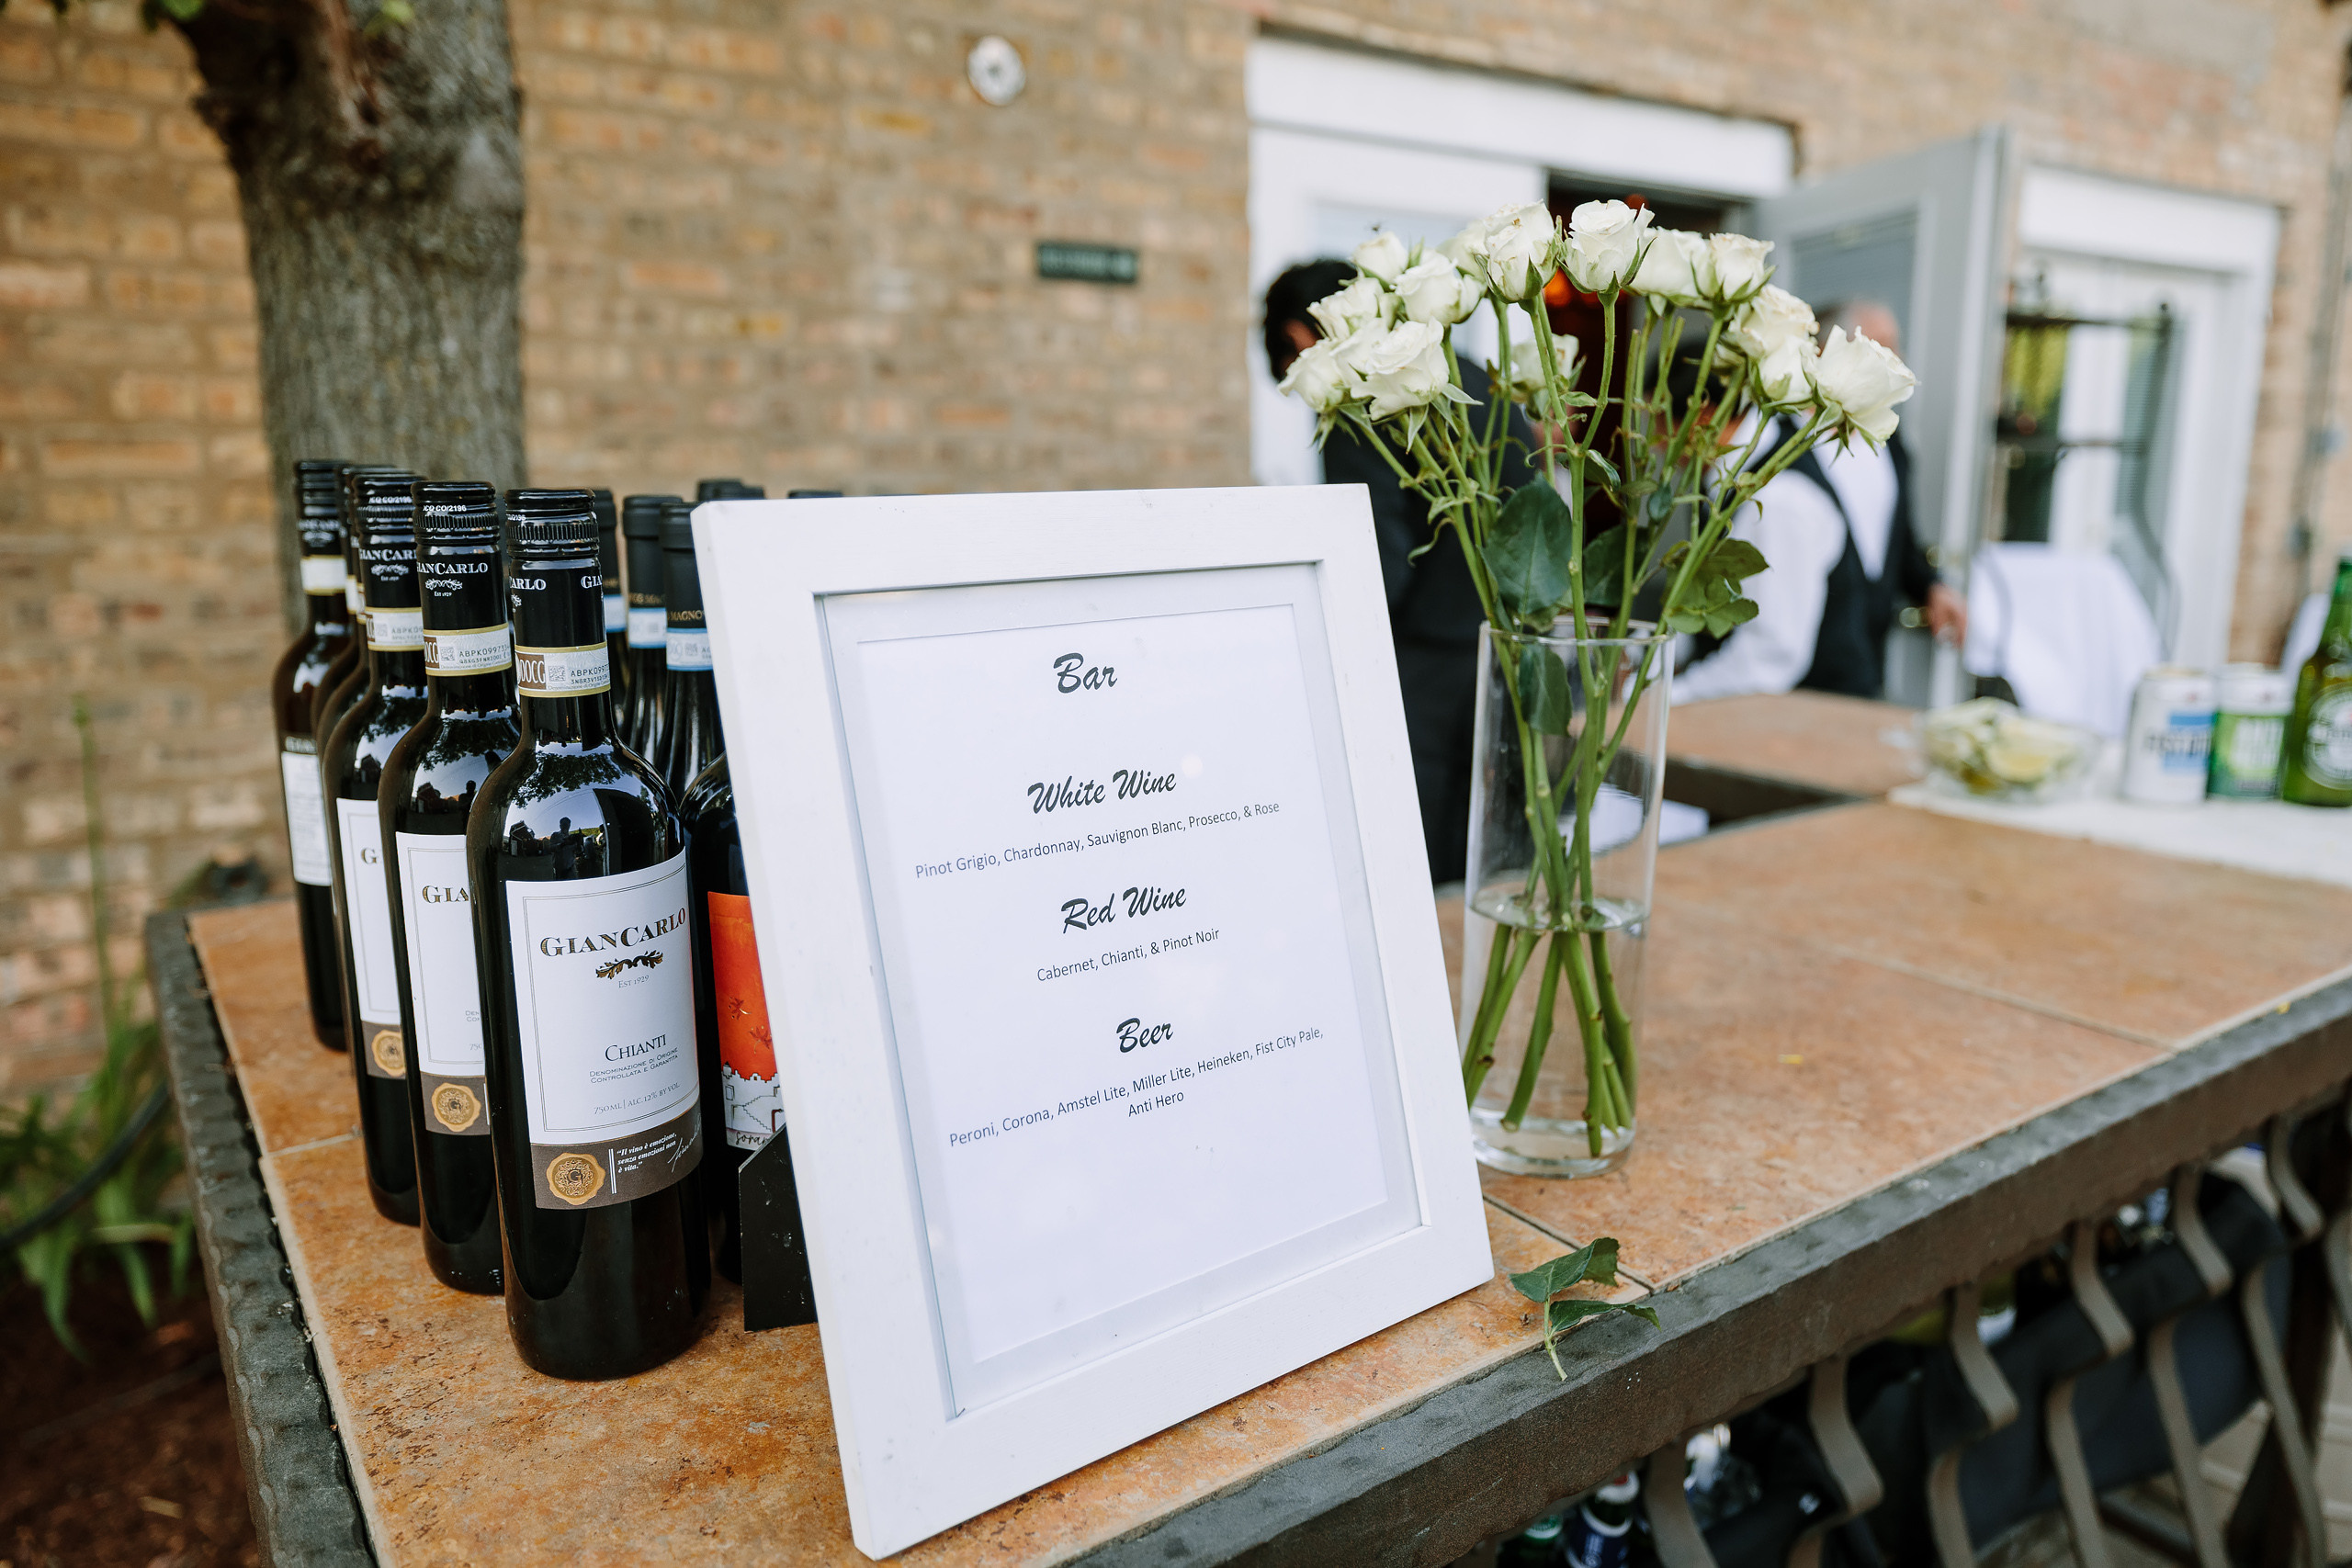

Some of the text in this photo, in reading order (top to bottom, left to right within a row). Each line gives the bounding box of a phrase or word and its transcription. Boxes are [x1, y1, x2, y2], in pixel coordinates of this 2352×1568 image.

[359, 548, 416, 561] IANCAR
[509, 577, 547, 590] ARLO
[1053, 653, 1118, 694] Bar
[1026, 769, 1177, 815] White Wine
[915, 802, 1280, 879] Pinot Grigio, Chardonnay, Sauvignon Blanc, Prosecco, & Rose
[1060, 886, 1187, 935] Red Wine
[1036, 927, 1220, 982] Cabernet, Chianti, & Pinot Noir
[633, 975, 650, 985] 1929
[605, 1033, 667, 1062] CHIANTI
[1115, 1017, 1174, 1054] Beer
[949, 1027, 1324, 1147] Peroni, Corona, Amstel Lite, Miller Lite, Heineken, Fist City Pale,
[1128, 1091, 1184, 1118] Anti Hero
[616, 1156, 637, 1166] senza
[638, 1144, 665, 1160] emozioni
[628, 1145, 644, 1154] vino
